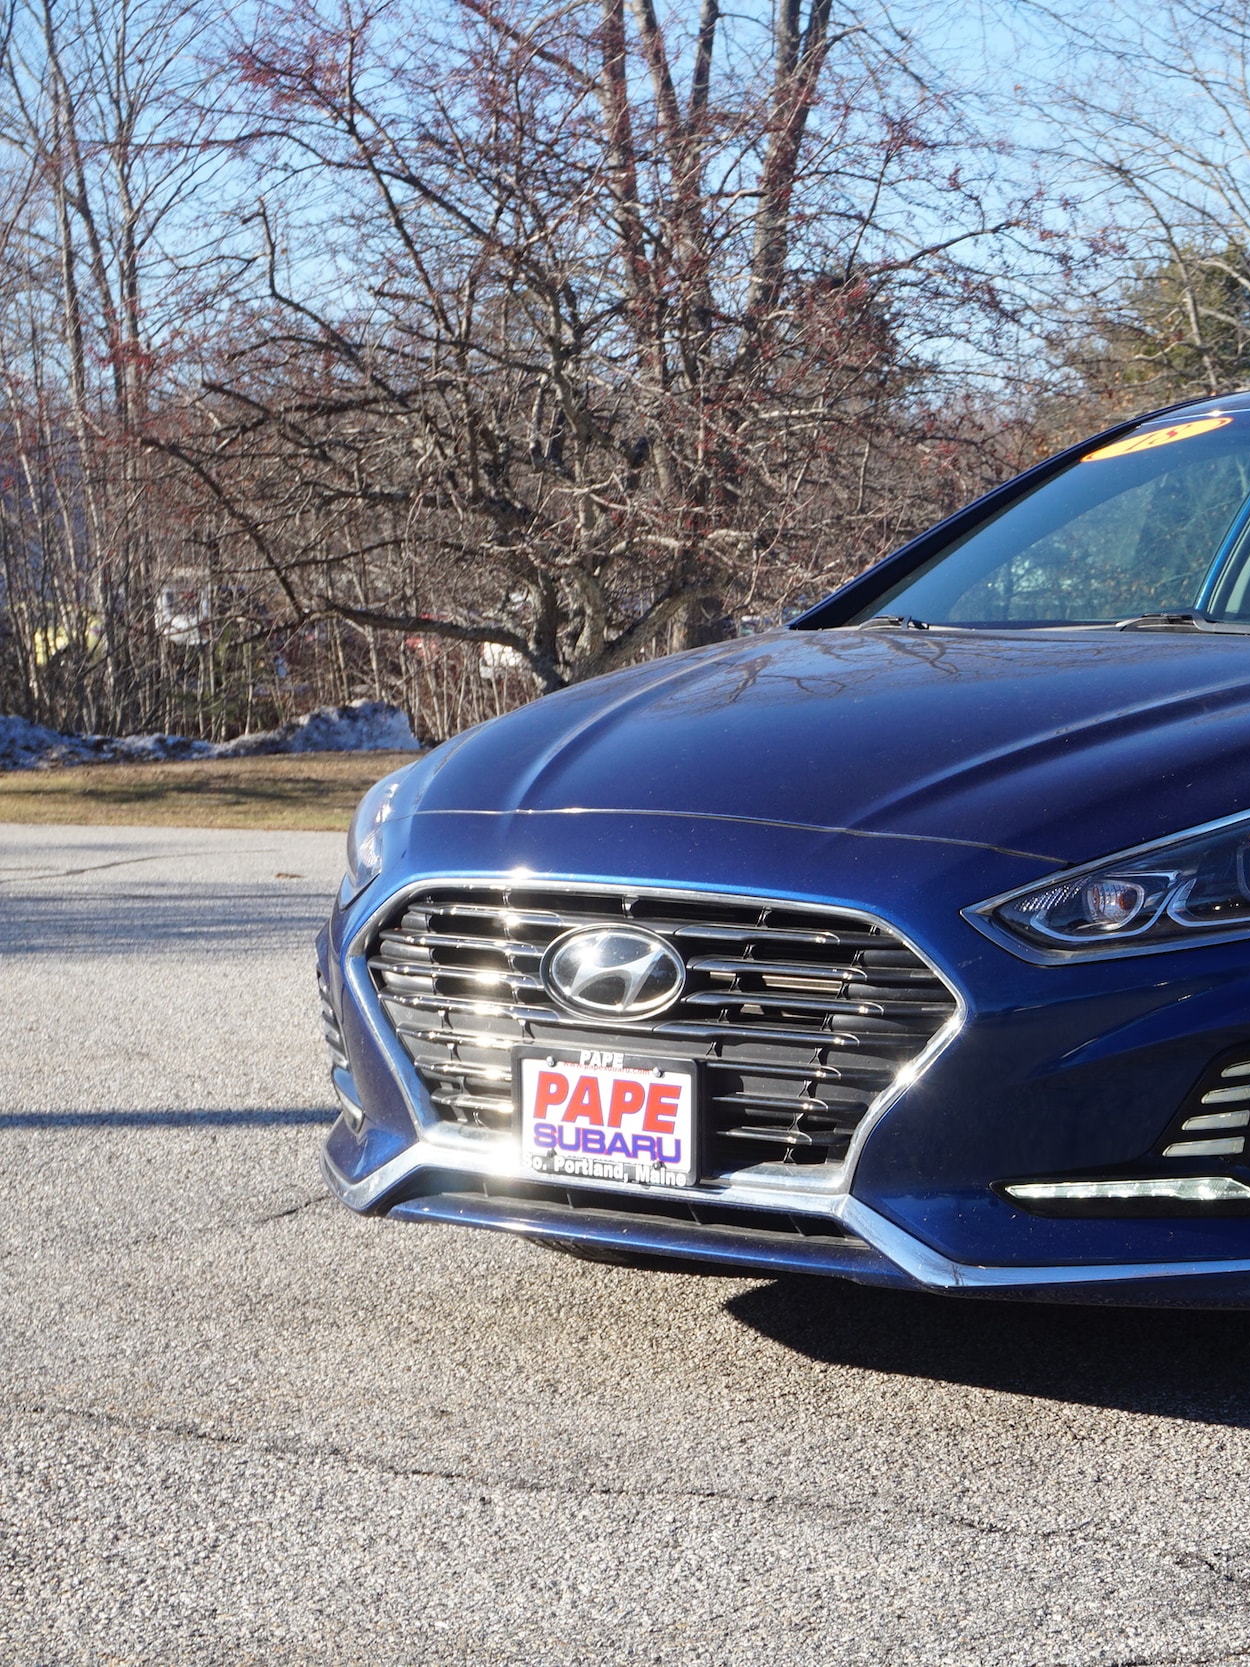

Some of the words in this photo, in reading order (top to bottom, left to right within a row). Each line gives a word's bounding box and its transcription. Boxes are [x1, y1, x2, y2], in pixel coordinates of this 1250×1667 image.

[580, 1050, 625, 1068] PAPE
[533, 1070, 682, 1134] PAPE
[533, 1123, 681, 1164] SUBARU
[523, 1153, 547, 1170] So.
[554, 1155, 629, 1183] Portland,
[635, 1164, 687, 1187] Maine
